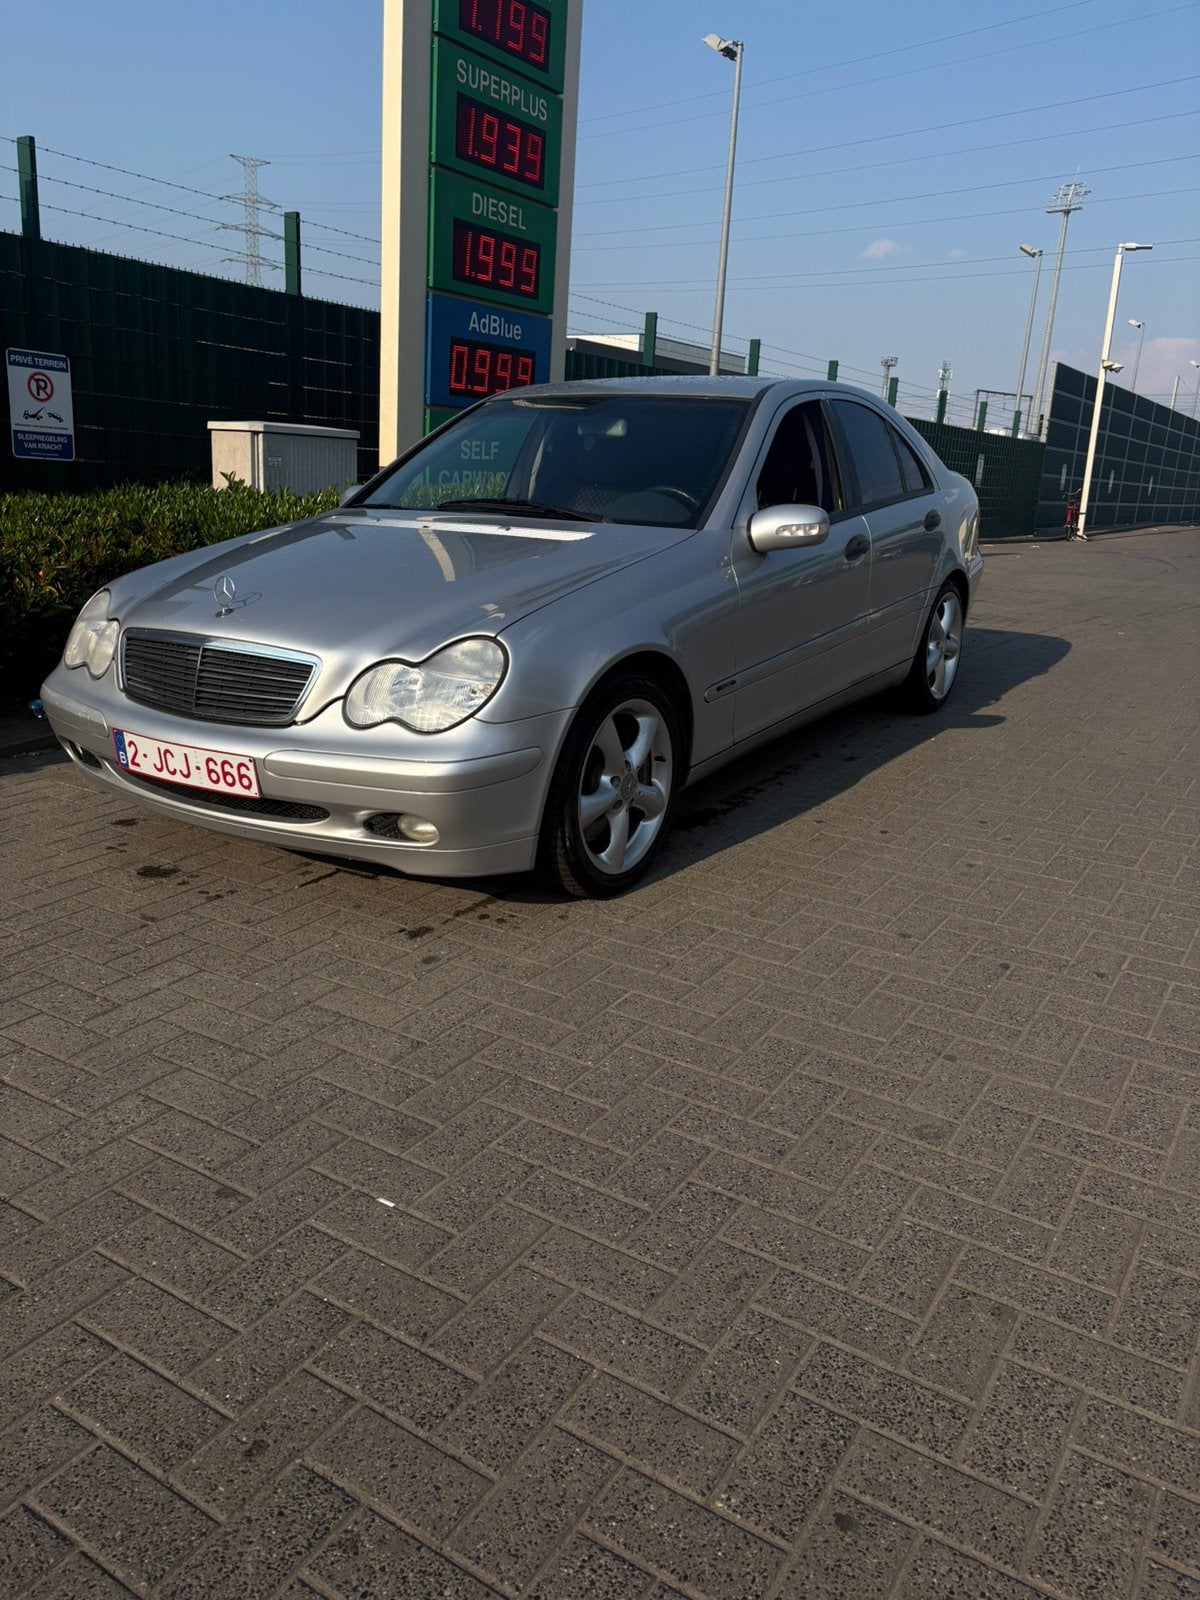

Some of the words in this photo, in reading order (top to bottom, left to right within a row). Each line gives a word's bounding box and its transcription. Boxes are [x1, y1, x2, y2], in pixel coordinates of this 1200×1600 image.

[457, 58, 548, 122] SUPERPLUS
[468, 107, 542, 182] 1.939
[472, 192, 527, 230] DIESEL
[465, 231, 538, 293] 1.999
[469, 310, 522, 340] AdBlue
[34, 357, 67, 369] TERREIN
[23, 441, 37, 449] VAN
[38, 442, 63, 451] KRACHT
[460, 440, 500, 460] SELF
[119, 751, 127, 764] B
